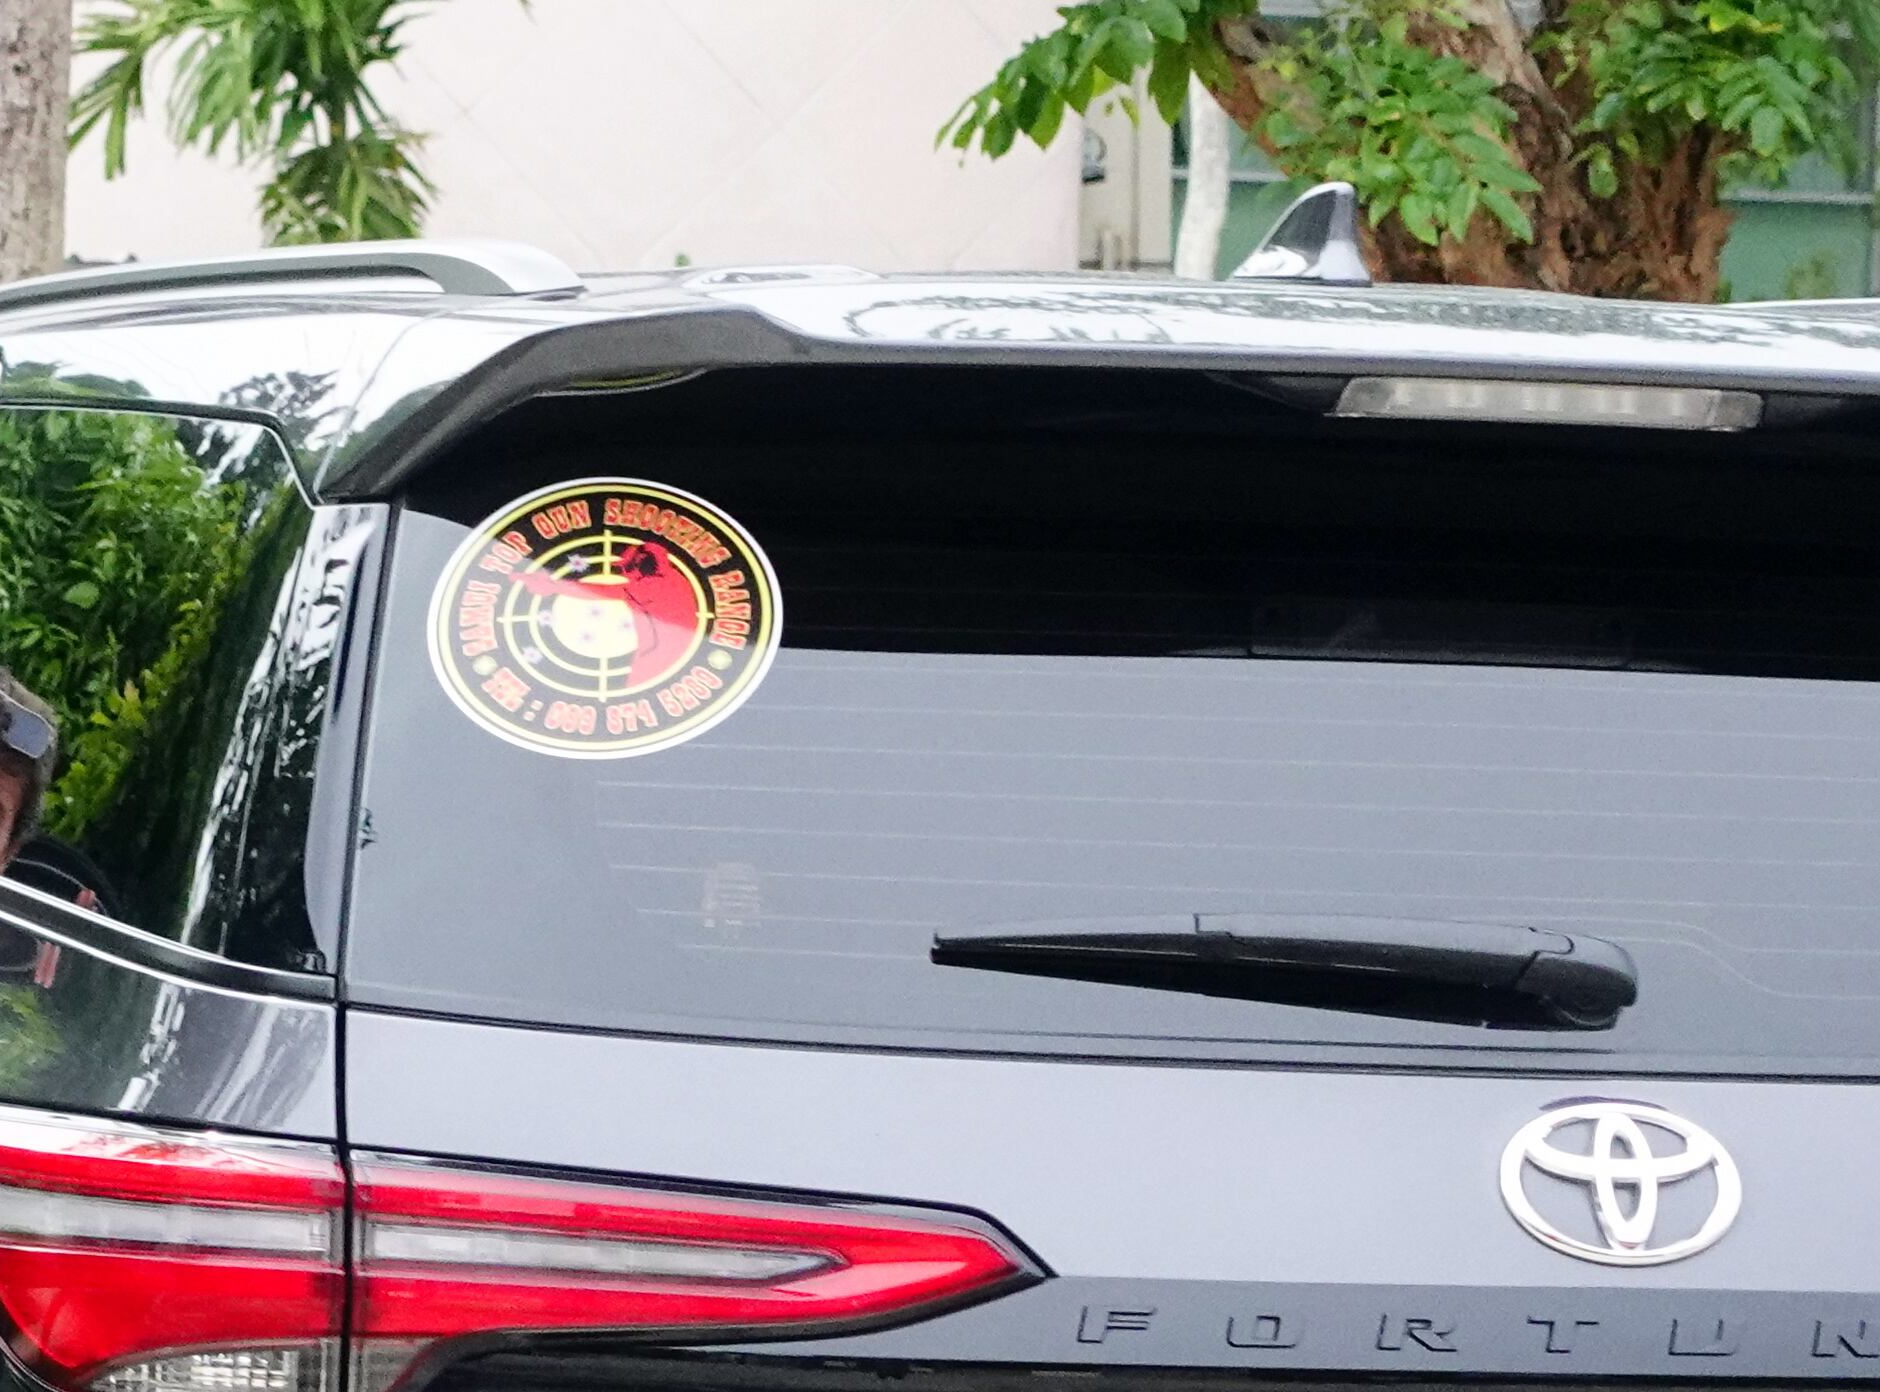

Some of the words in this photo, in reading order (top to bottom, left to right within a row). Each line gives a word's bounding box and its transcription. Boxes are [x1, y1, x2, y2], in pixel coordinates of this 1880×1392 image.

[461, 580, 500, 656] SAMUI
[481, 532, 533, 574] TOP
[532, 500, 592, 539] GUN
[604, 499, 731, 567] SHOOTING
[710, 570, 751, 649] RANGE
